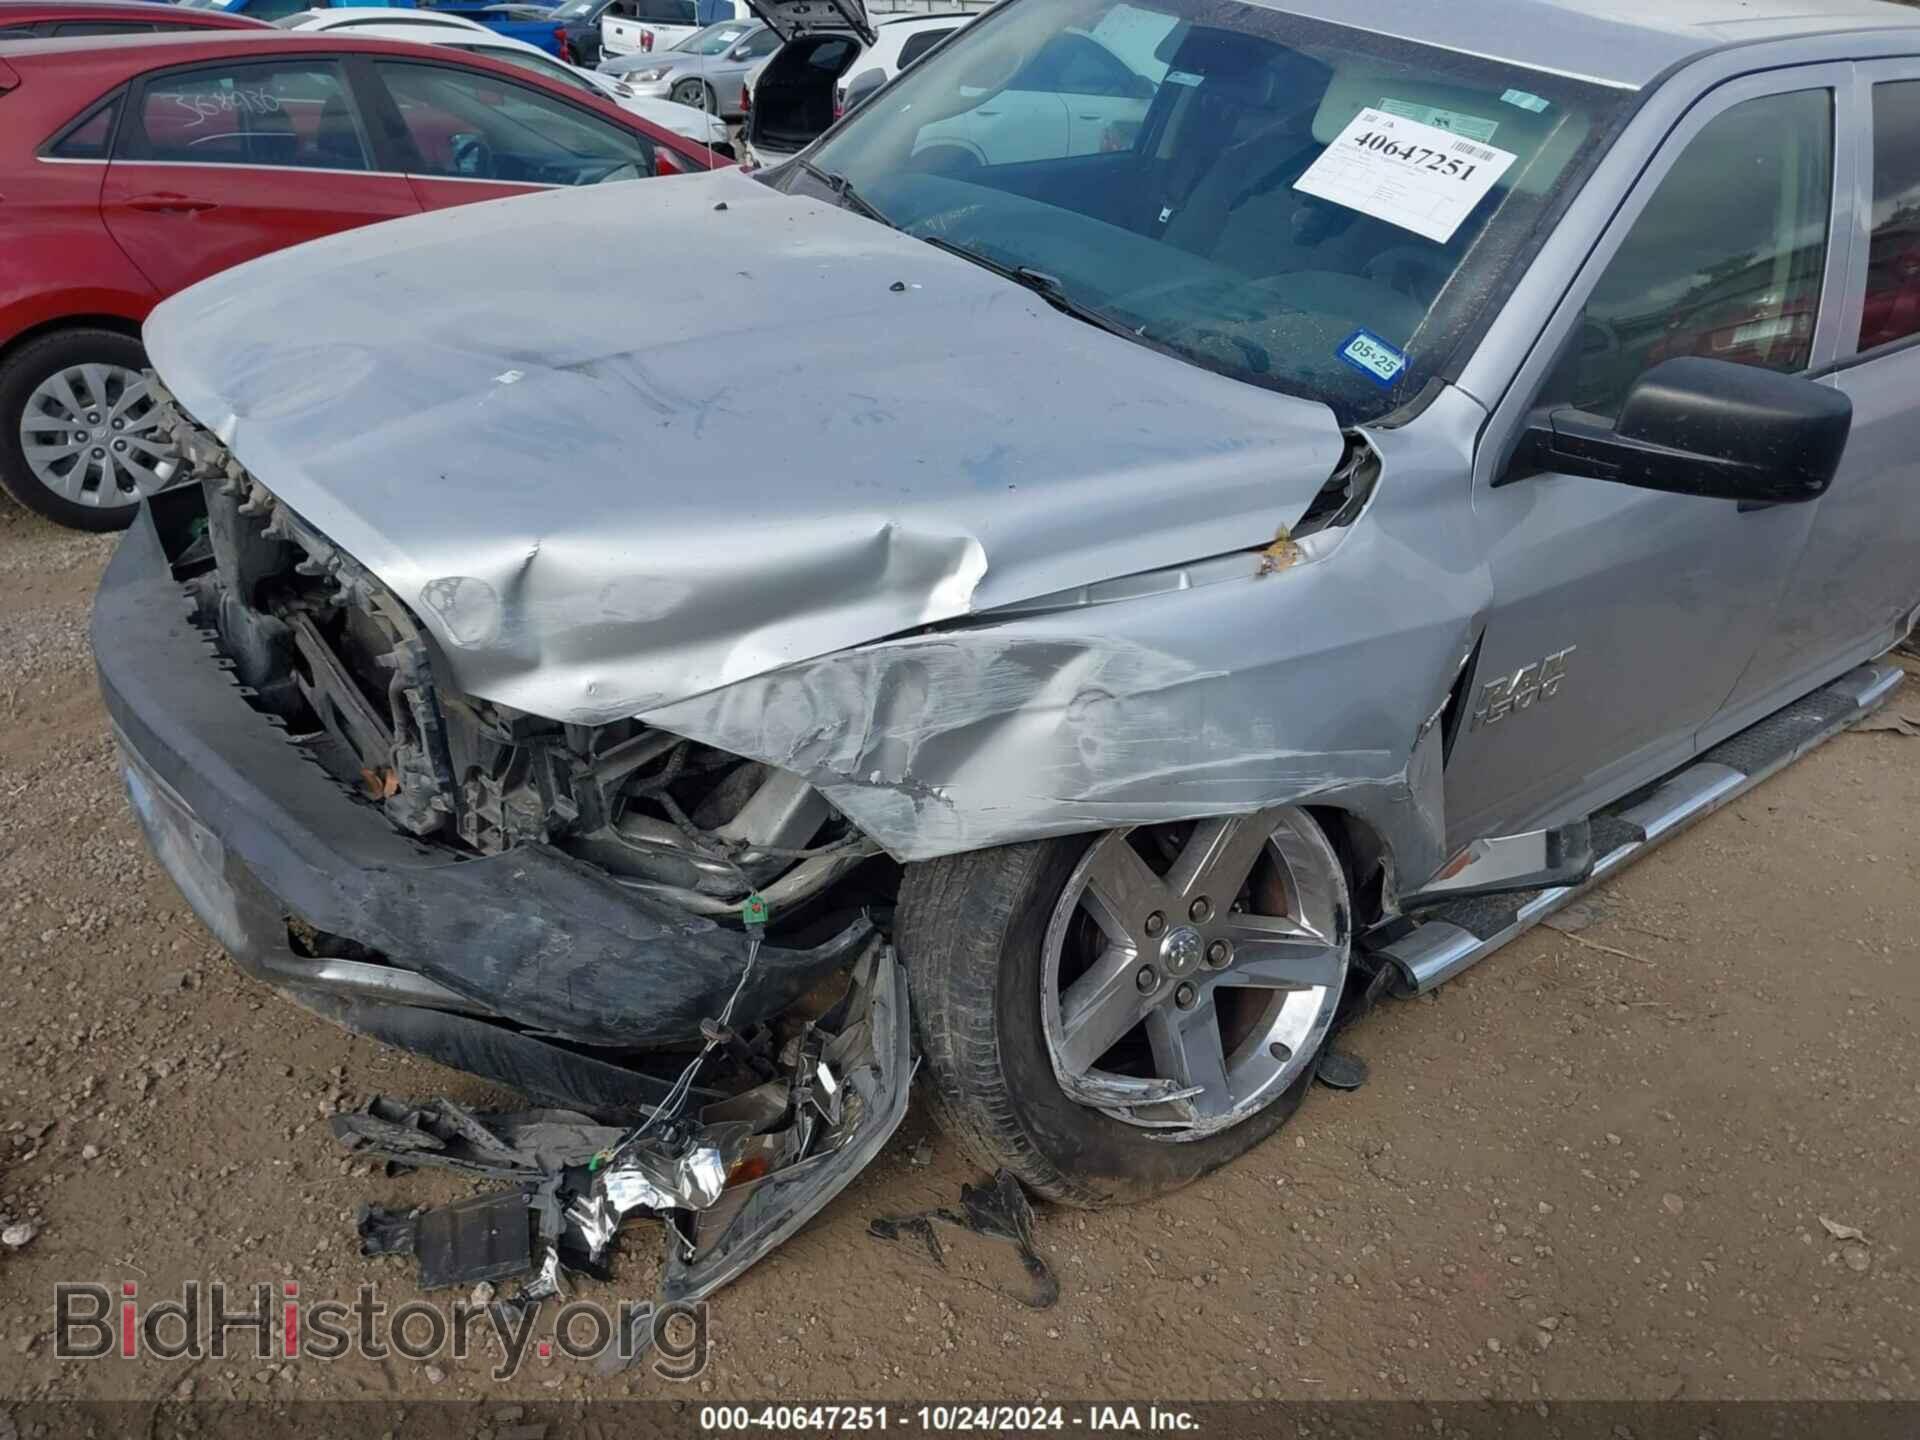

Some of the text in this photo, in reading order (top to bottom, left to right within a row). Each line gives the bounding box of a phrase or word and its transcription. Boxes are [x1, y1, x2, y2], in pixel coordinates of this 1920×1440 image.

[1354, 131, 1477, 181] 40647251
[1352, 340, 1397, 373] 05 25
